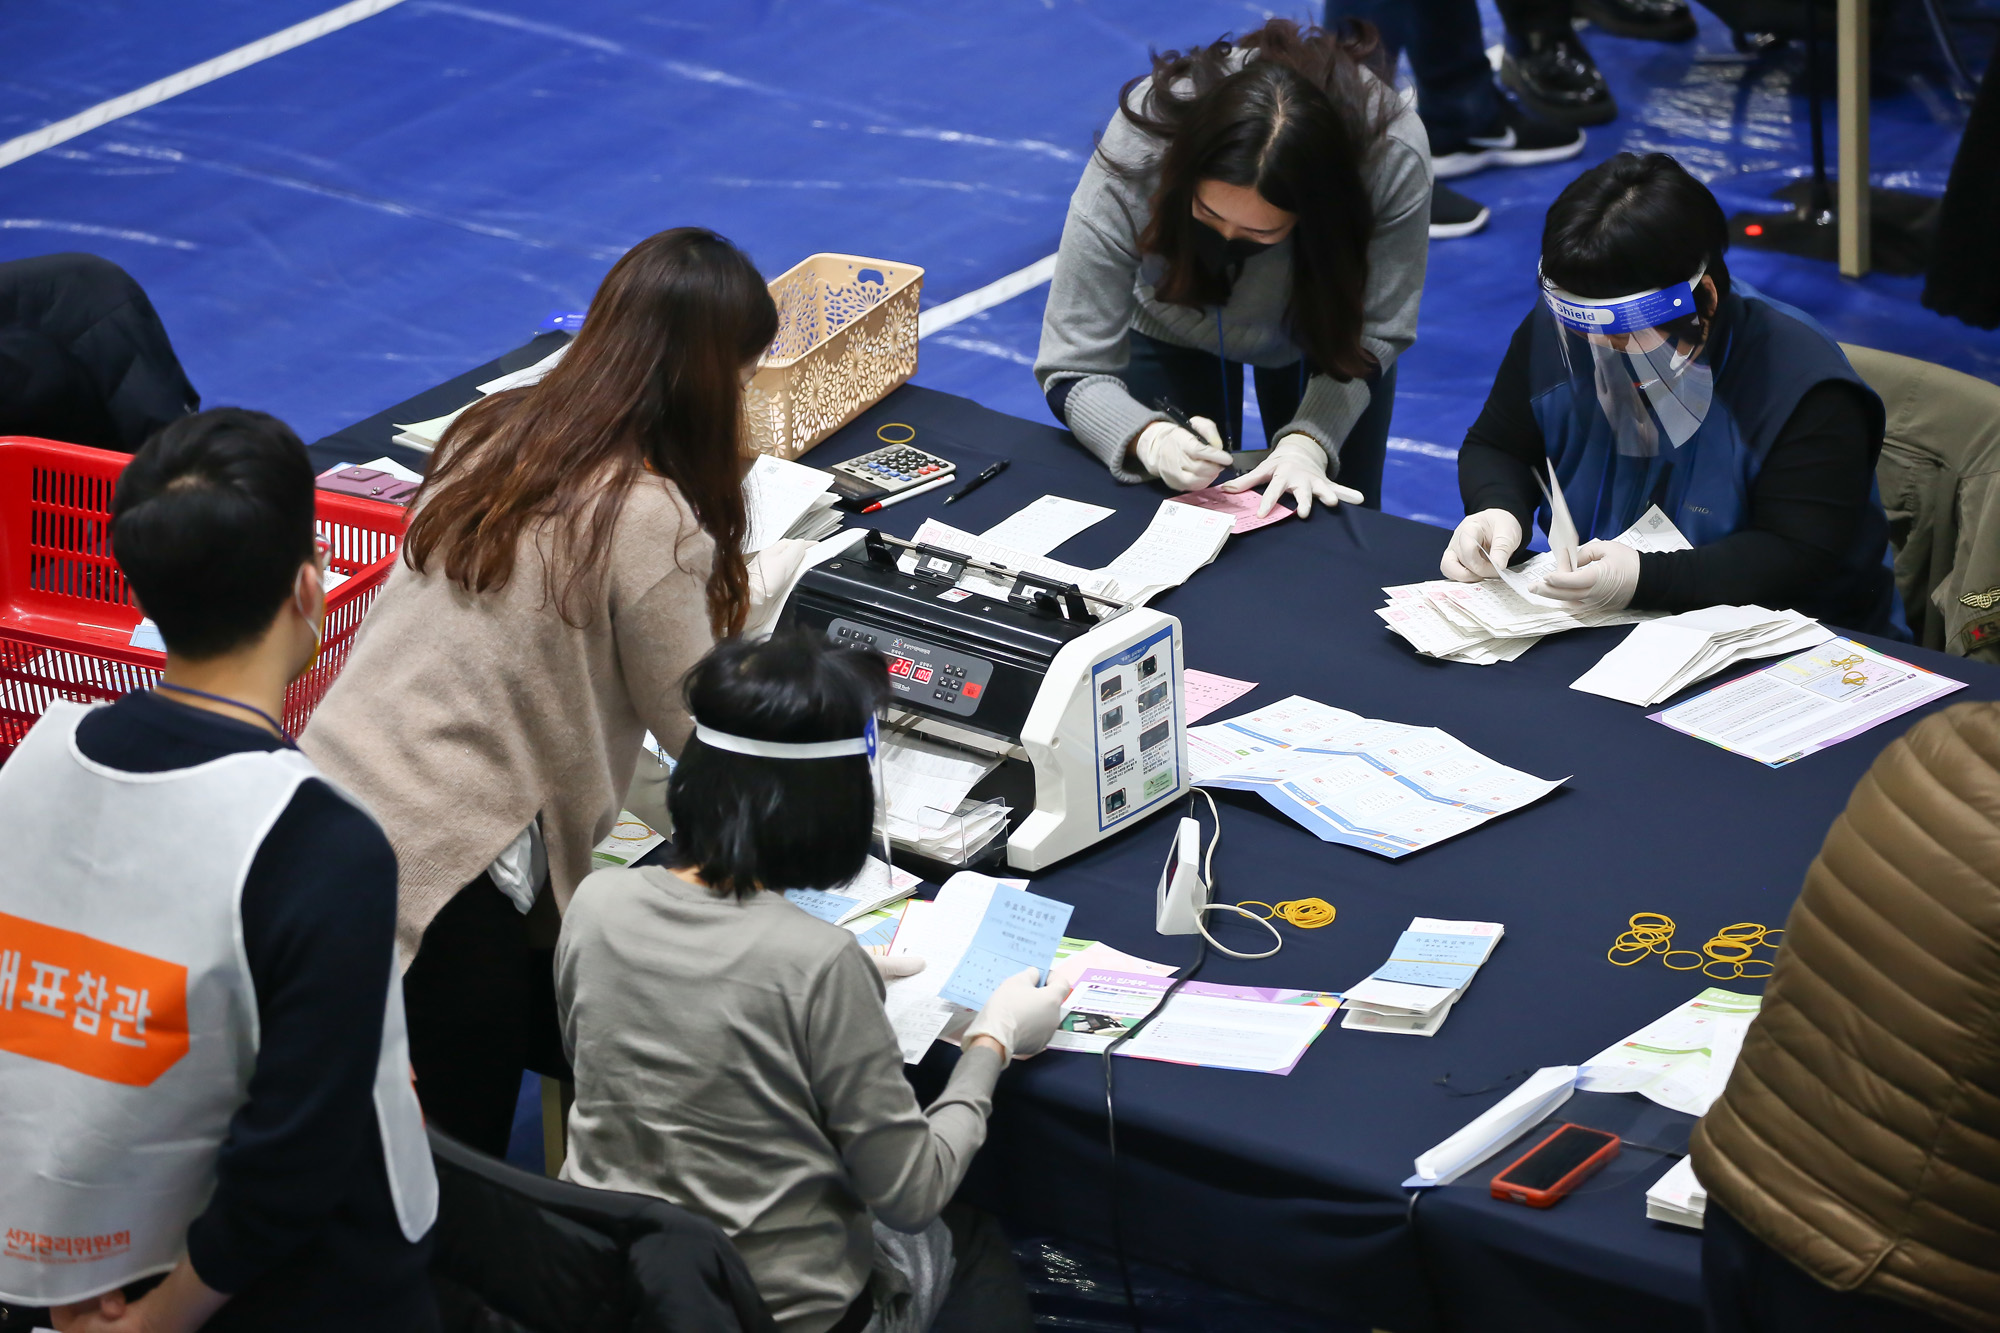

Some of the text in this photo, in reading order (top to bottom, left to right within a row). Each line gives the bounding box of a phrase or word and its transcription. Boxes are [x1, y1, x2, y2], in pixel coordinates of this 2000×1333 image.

[1555, 302, 1595, 321] Shield
[892, 659, 911, 676] 26
[914, 669, 932, 681] 100
[5, 1227, 131, 1256] 선거관리위원회
